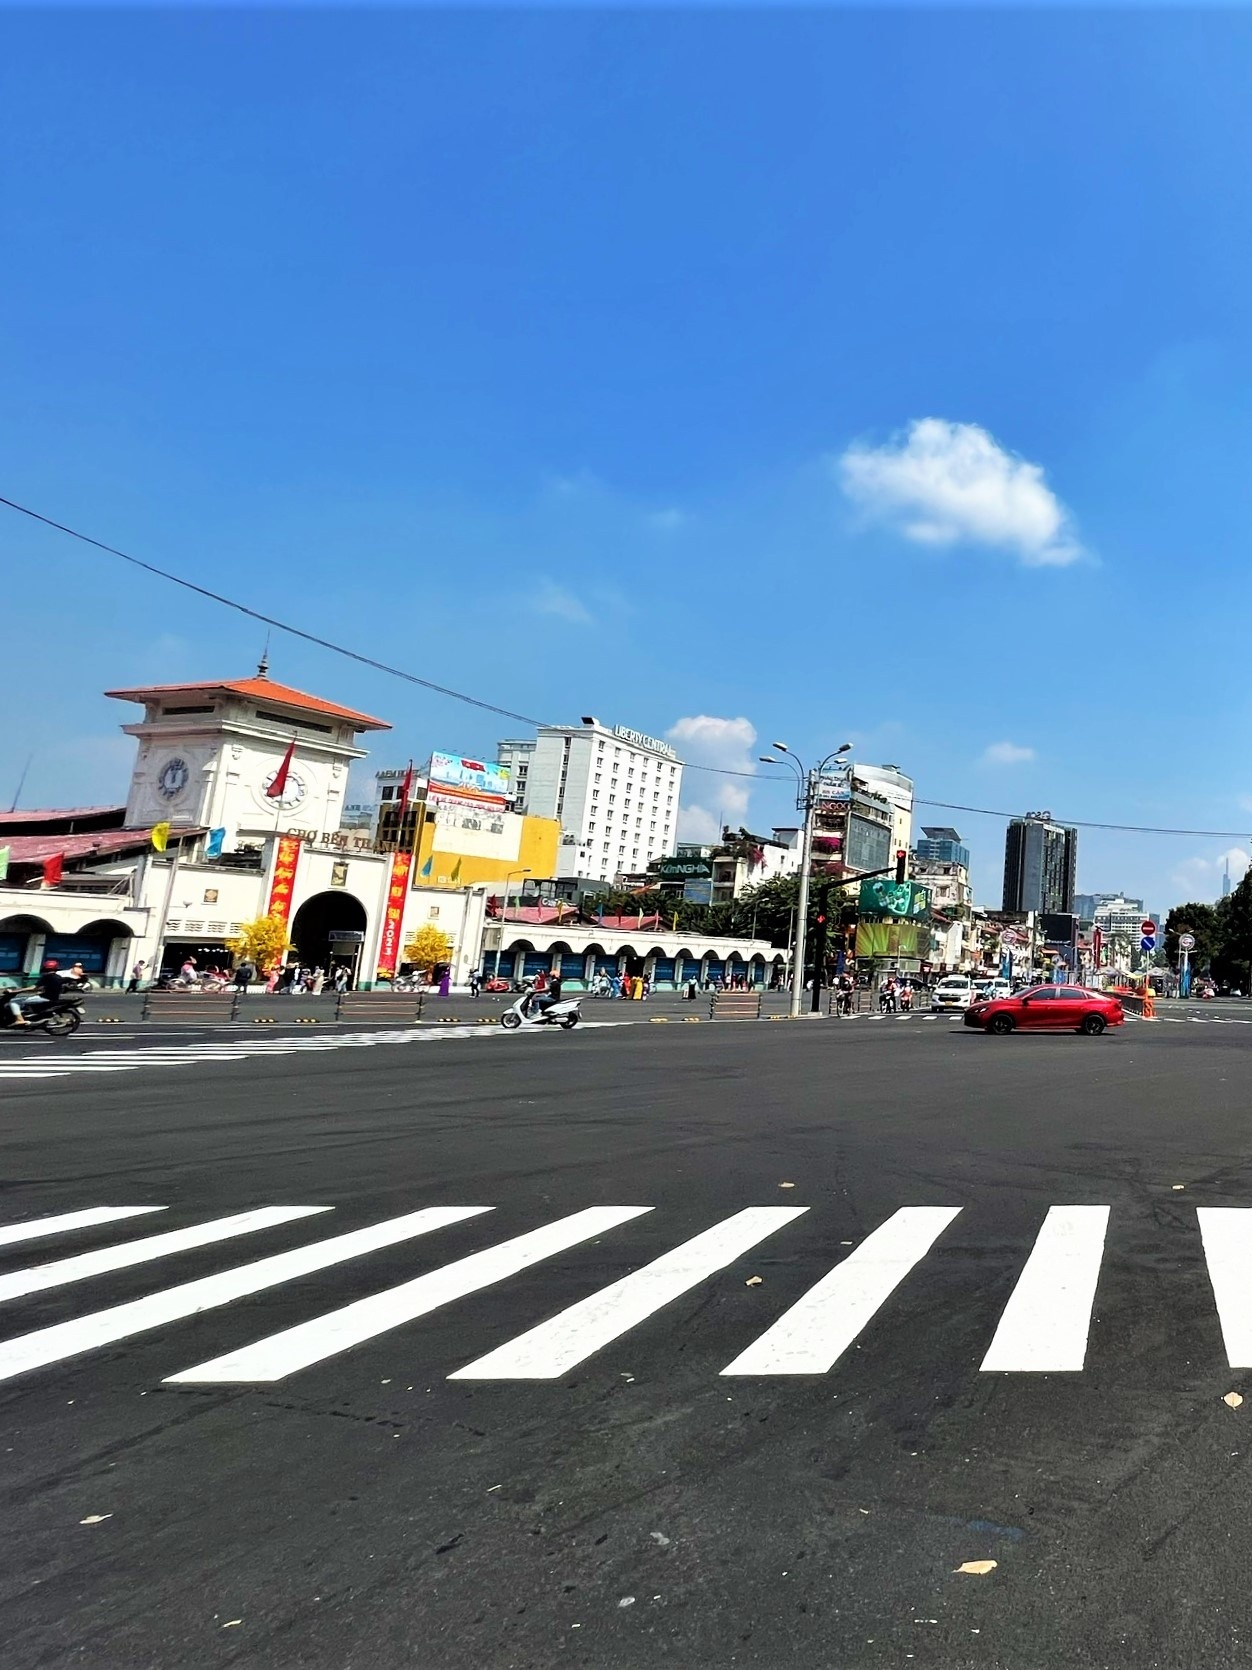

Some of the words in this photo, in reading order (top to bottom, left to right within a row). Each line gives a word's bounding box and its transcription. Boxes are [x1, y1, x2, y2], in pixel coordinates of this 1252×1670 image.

[615, 724, 643, 745] LIBERTY
[643, 734, 673, 756] CENTRAL
[384, 919, 395, 956] 2023
